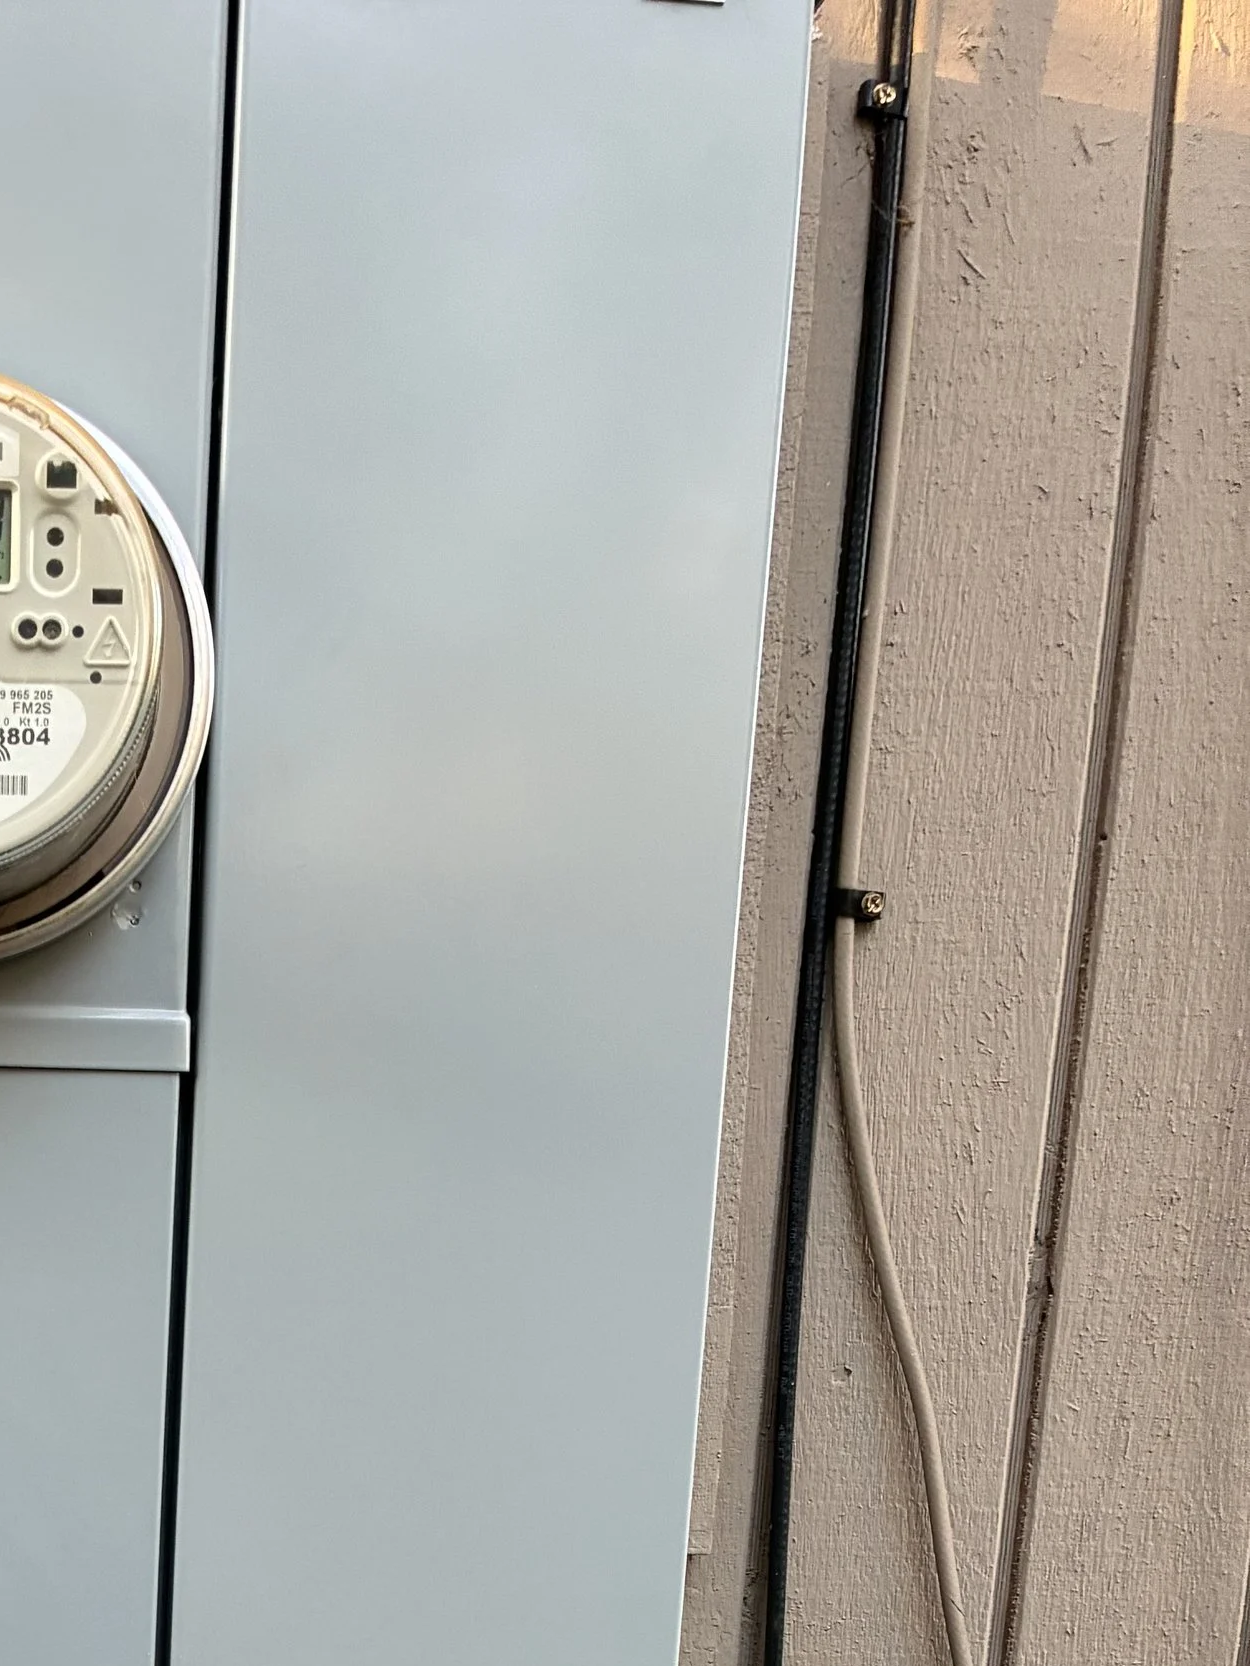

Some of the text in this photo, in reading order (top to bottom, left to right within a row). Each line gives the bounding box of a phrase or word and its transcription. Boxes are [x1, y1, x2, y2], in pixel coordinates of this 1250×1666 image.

[10, 690, 30, 700] 965
[34, 690, 53, 700] 205
[12, 702, 52, 715] FM2S
[19, 716, 31, 727] Kt
[35, 717, 49, 727] 1.0
